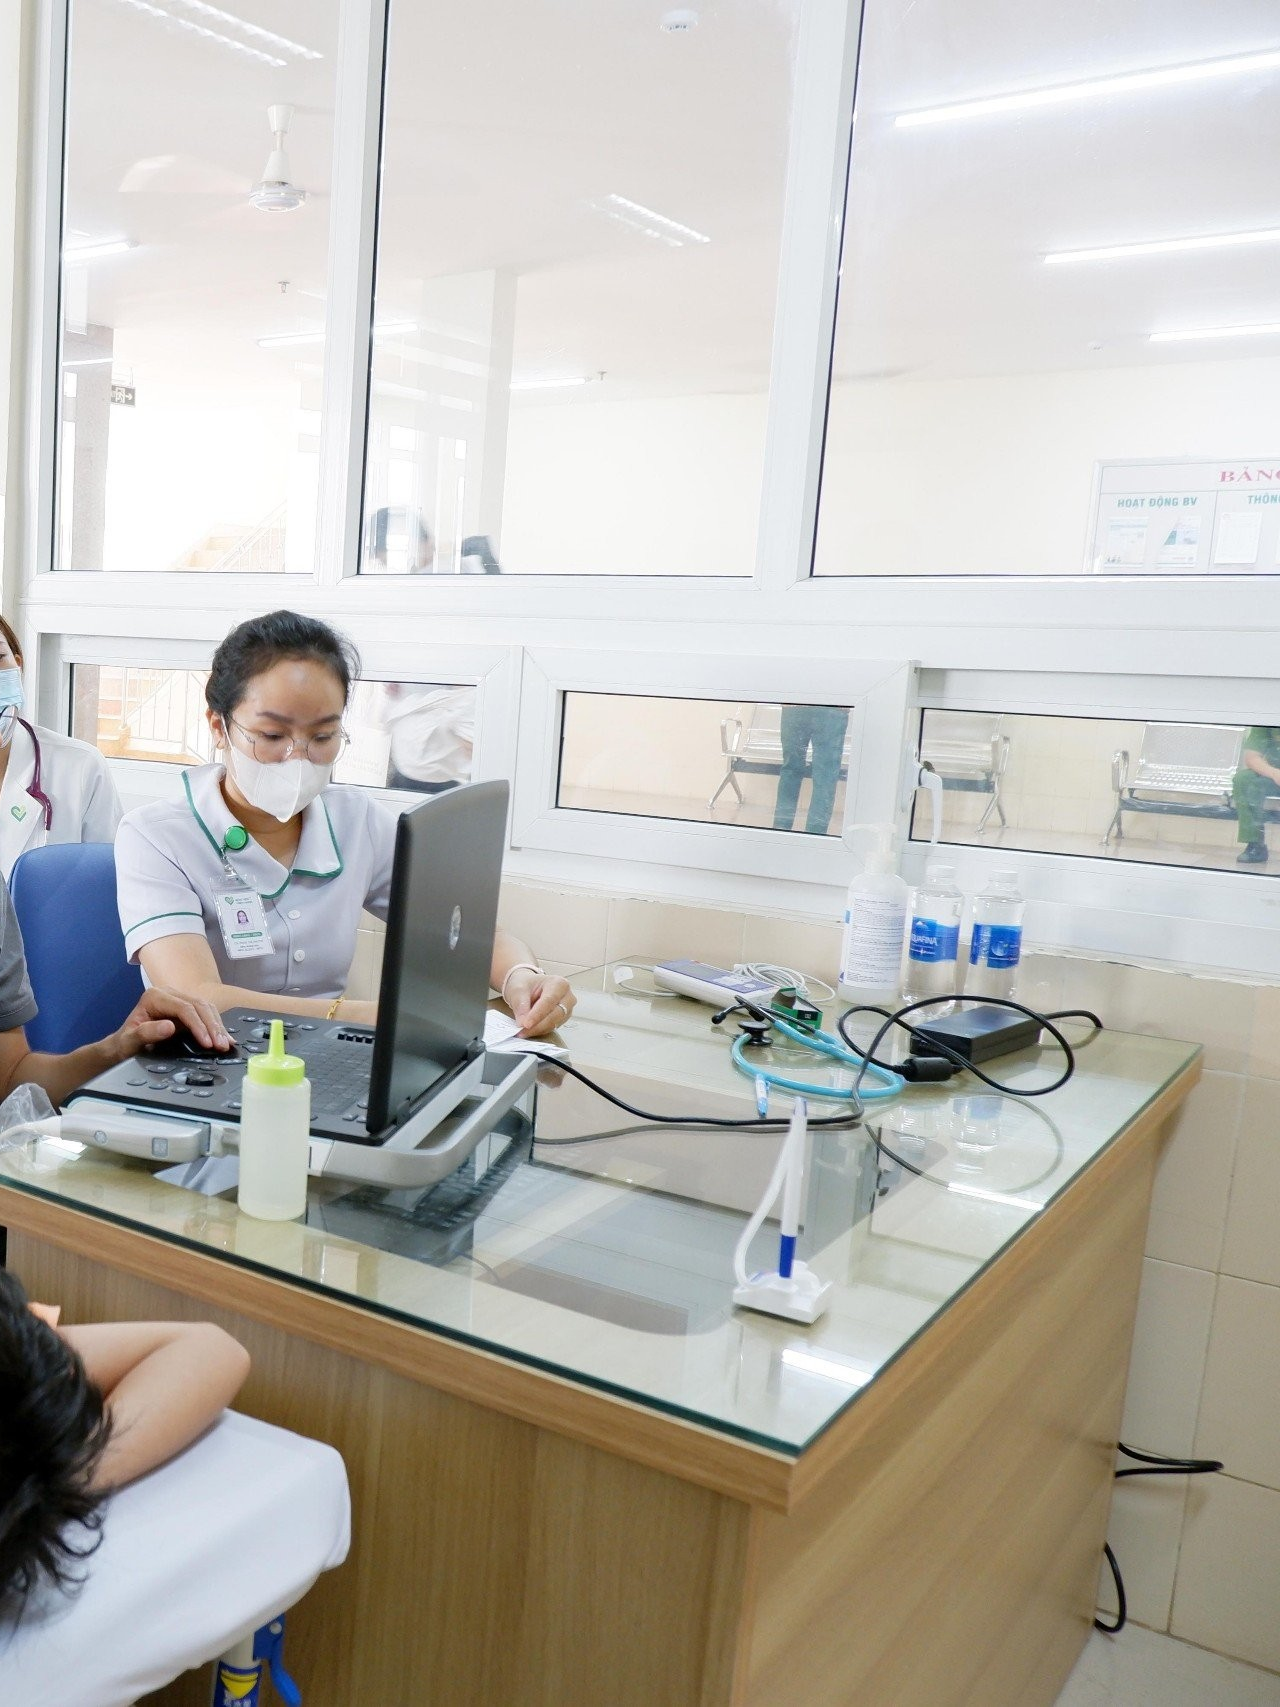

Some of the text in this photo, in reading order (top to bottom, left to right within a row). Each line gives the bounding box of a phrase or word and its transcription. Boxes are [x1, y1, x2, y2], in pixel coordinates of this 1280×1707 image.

[1149, 495, 1179, 509] ĐỘNG
[1182, 497, 1198, 506] BV
[1248, 493, 1280, 504] THÔN
